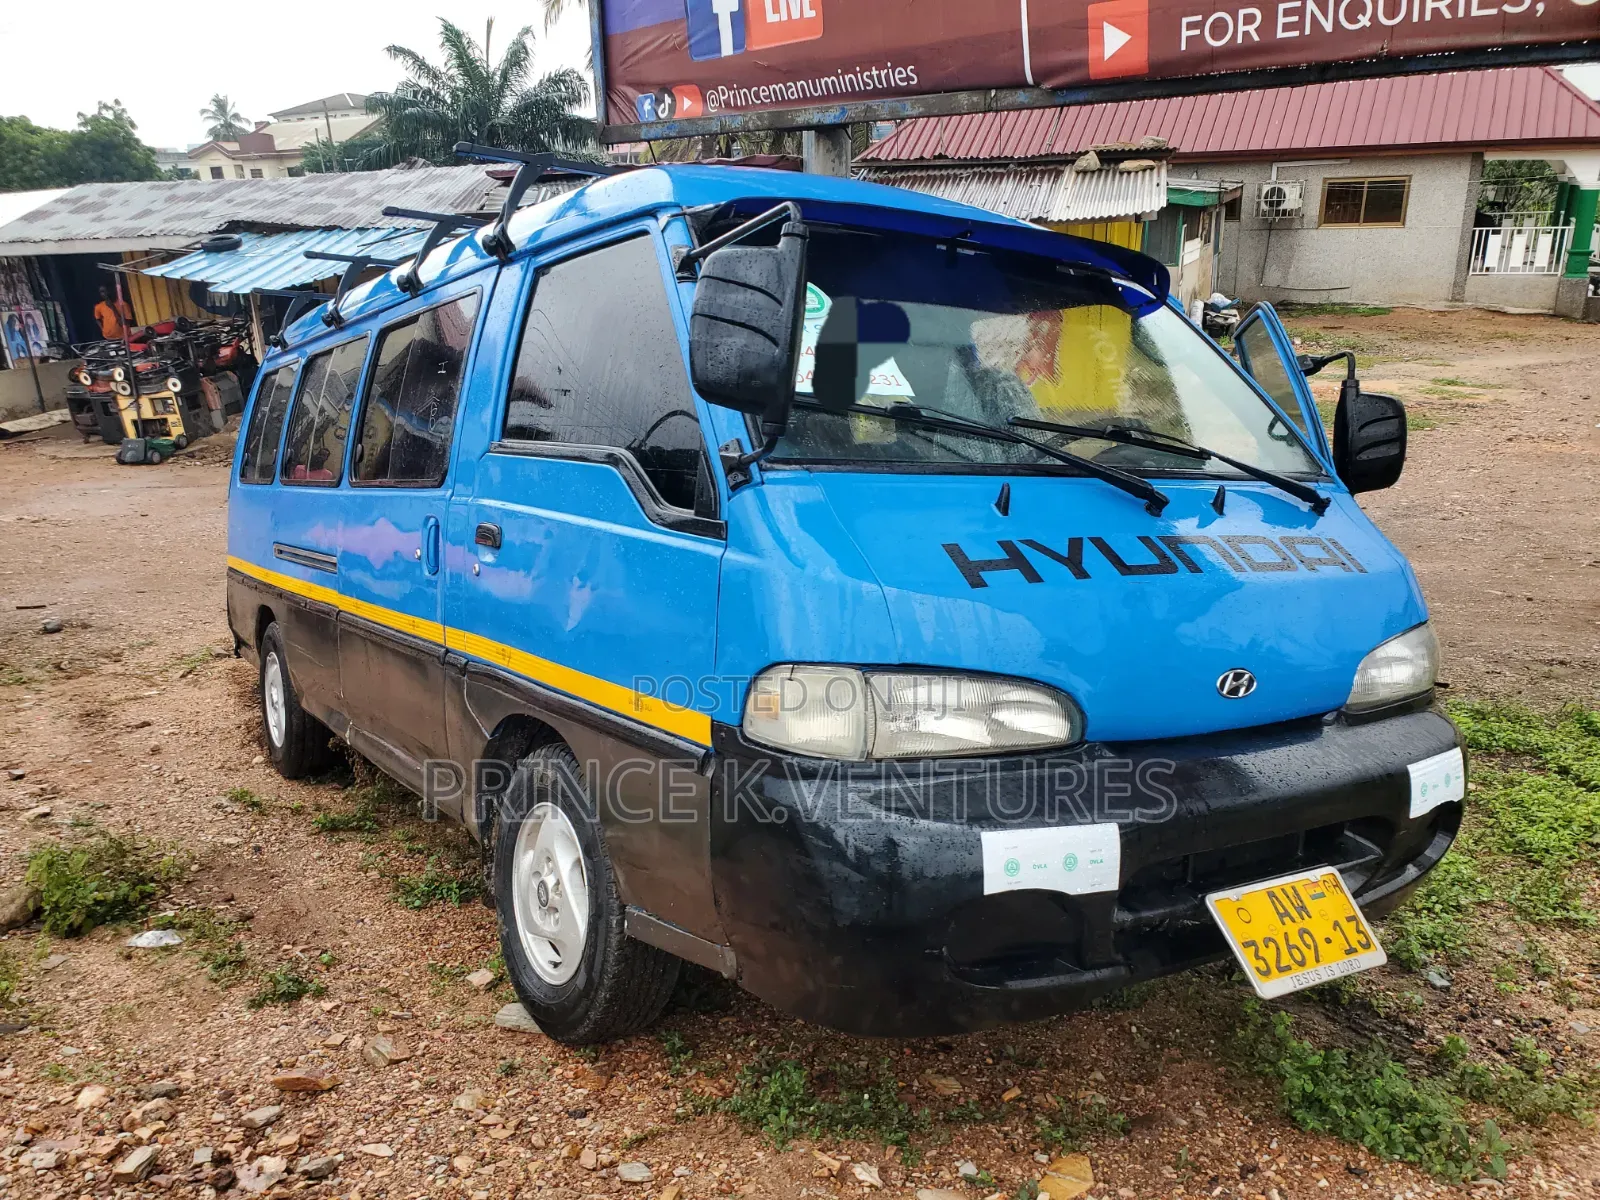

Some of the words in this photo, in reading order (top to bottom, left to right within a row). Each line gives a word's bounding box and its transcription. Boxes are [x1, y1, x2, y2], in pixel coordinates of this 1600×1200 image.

[1180, 7, 1262, 51] FOR
[706, 62, 918, 113] @Princemanuministries
[941, 535, 1368, 589] HYUNDAI
[1266, 885, 1312, 926] AW
[1289, 969, 1322, 988] JESUS
